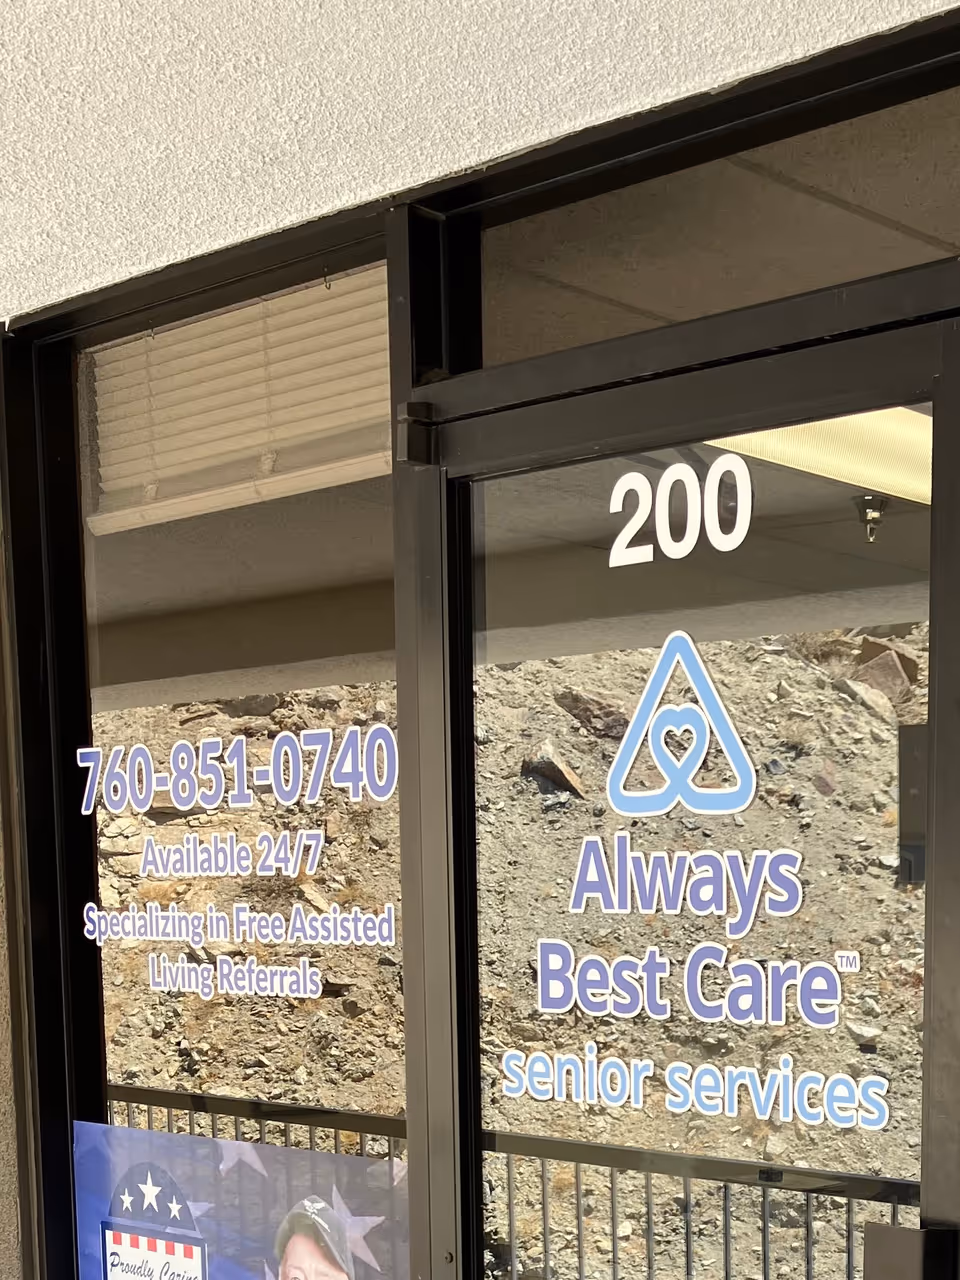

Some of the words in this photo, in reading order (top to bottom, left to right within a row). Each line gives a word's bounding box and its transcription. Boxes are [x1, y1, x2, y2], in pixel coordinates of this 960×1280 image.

[609, 453, 752, 568] 200
[77, 724, 398, 815] 760-851-0740
[140, 835, 251, 877] Available
[256, 830, 323, 877] 24/7
[569, 831, 803, 939] Always
[84, 903, 204, 945] Specializing
[207, 904, 229, 940] in
[233, 904, 285, 941] Free
[289, 903, 395, 946] Assisted
[149, 954, 213, 999] Living
[217, 955, 322, 998] Referrals
[537, 938, 670, 1020] Best
[501, 1041, 653, 1108] senior
[665, 1053, 889, 1131] services
